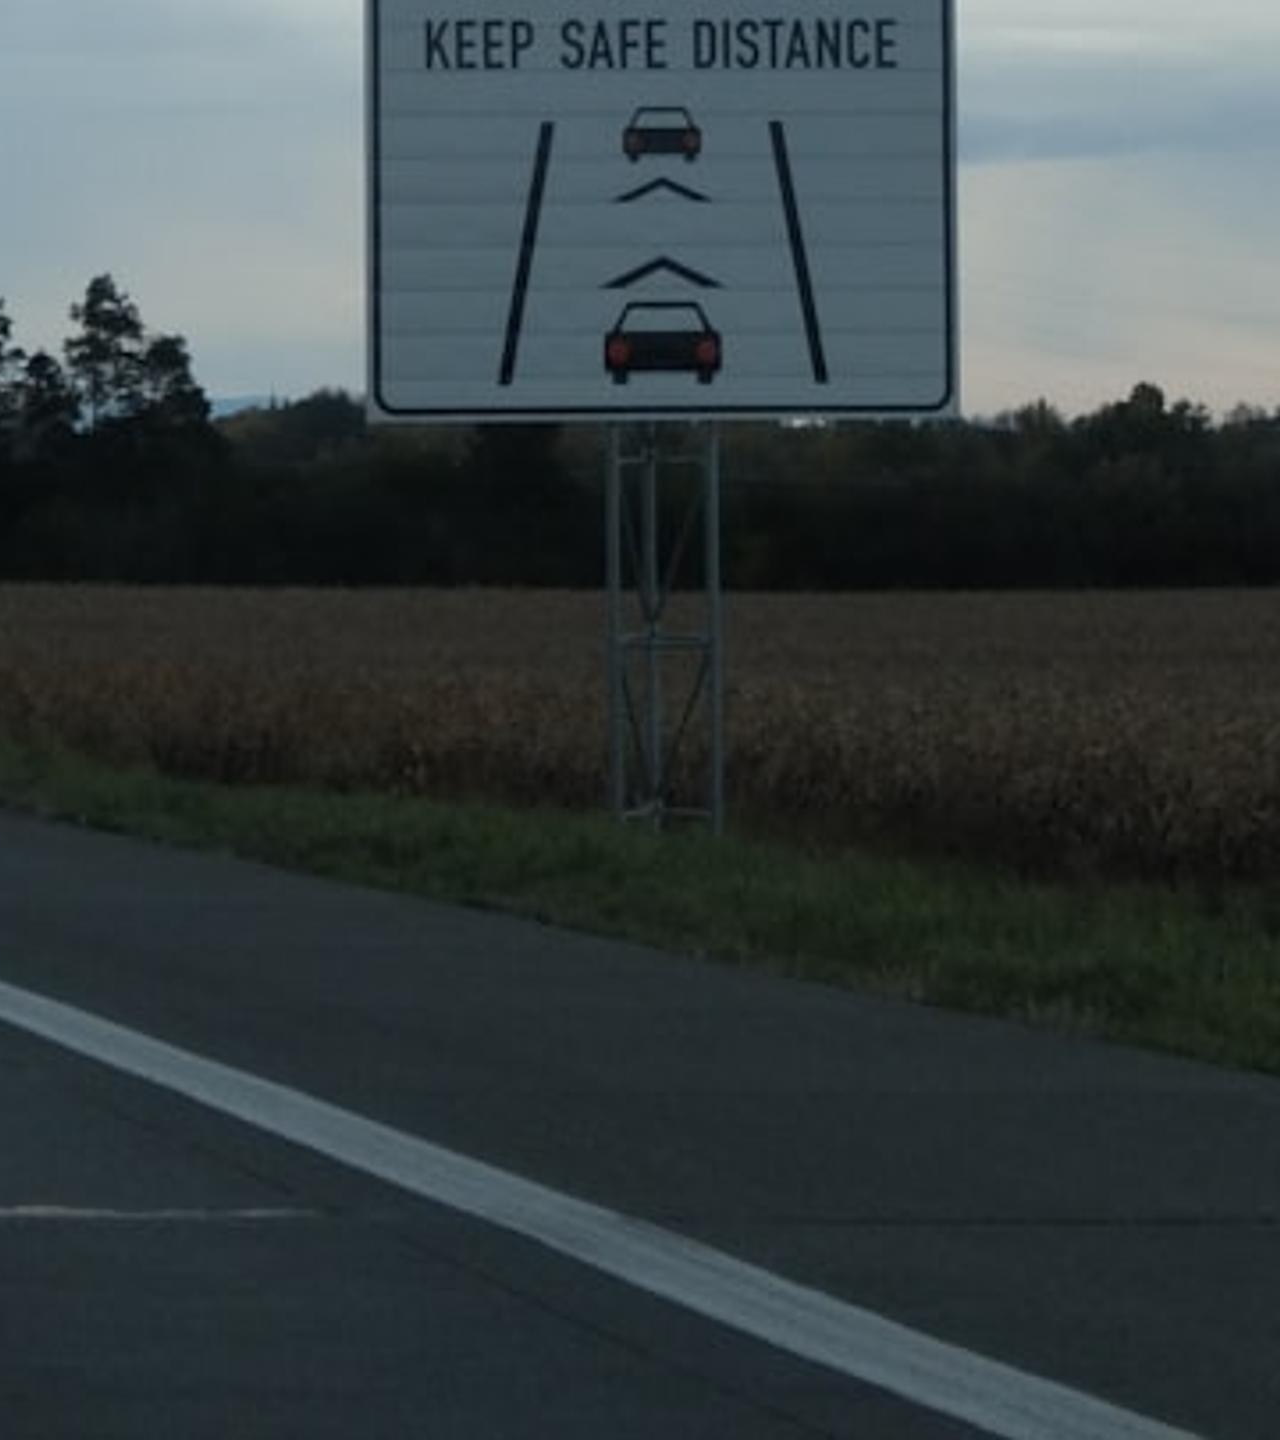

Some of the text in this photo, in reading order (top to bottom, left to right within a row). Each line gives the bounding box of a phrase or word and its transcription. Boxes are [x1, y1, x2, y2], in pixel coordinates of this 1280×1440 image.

[424, 19, 898, 69] KEEP SAFE DISTANCE
